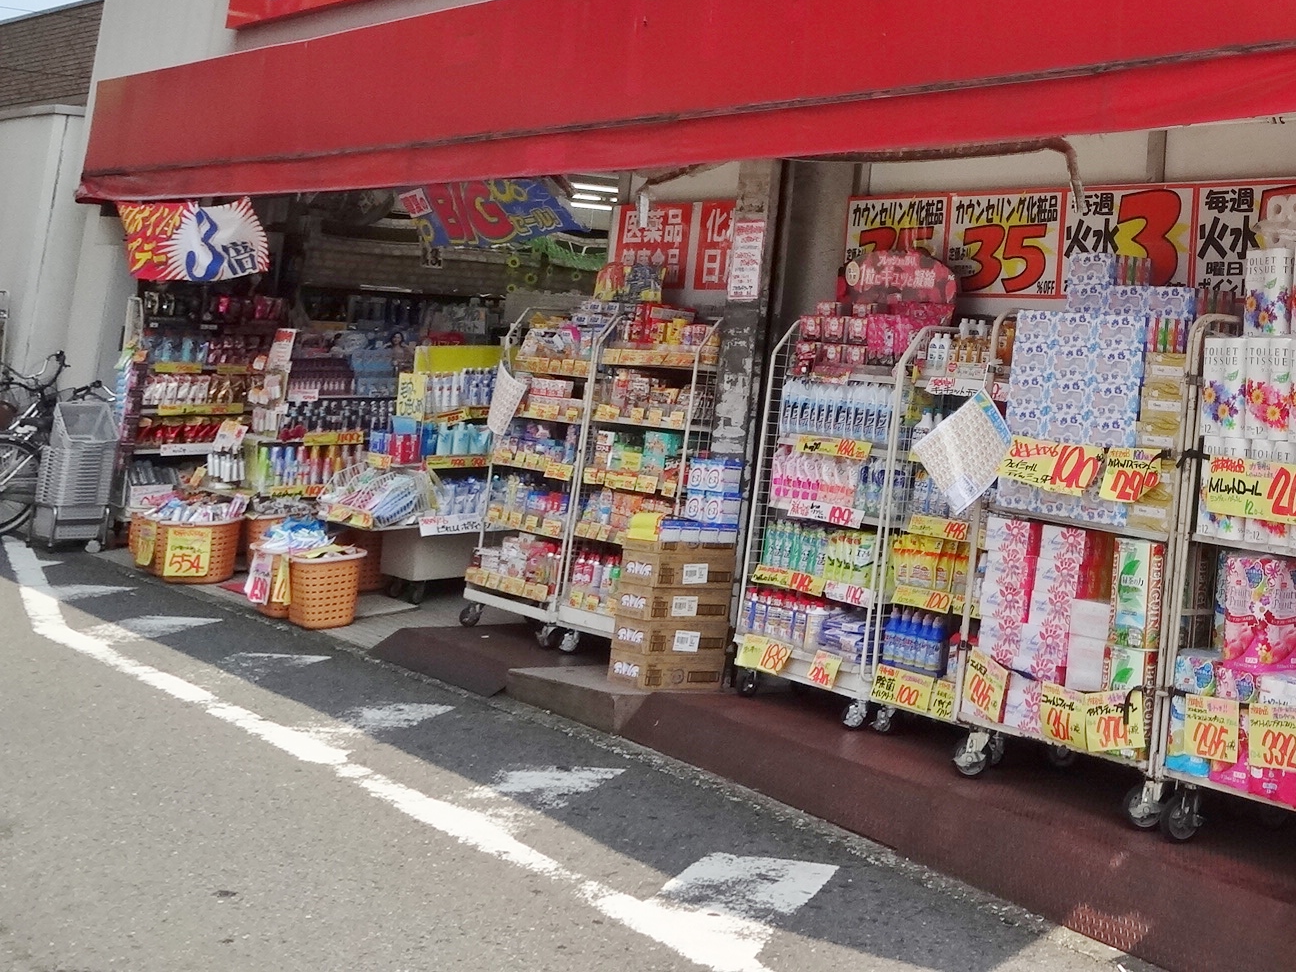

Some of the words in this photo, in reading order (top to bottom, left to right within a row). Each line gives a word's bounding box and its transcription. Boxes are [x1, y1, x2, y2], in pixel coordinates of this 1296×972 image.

[852, 199, 944, 227] カウンセリング化粧品
[955, 195, 1058, 224] カウンセリング化粧品
[1205, 187, 1255, 214] 毎週
[623, 208, 683, 244] 医薬品
[1064, 218, 1121, 259] 火水
[1117, 188, 1182, 286] 3
[1197, 215, 1260, 260] 火水
[962, 224, 1048, 294] 35
[1206, 261, 1244, 277] 曜日
[1249, 347, 1289, 357] TOILET
[1249, 357, 1289, 367] TISSUE
[168, 554, 206, 575] 554
[1150, 555, 1164, 634] PENGUIN
